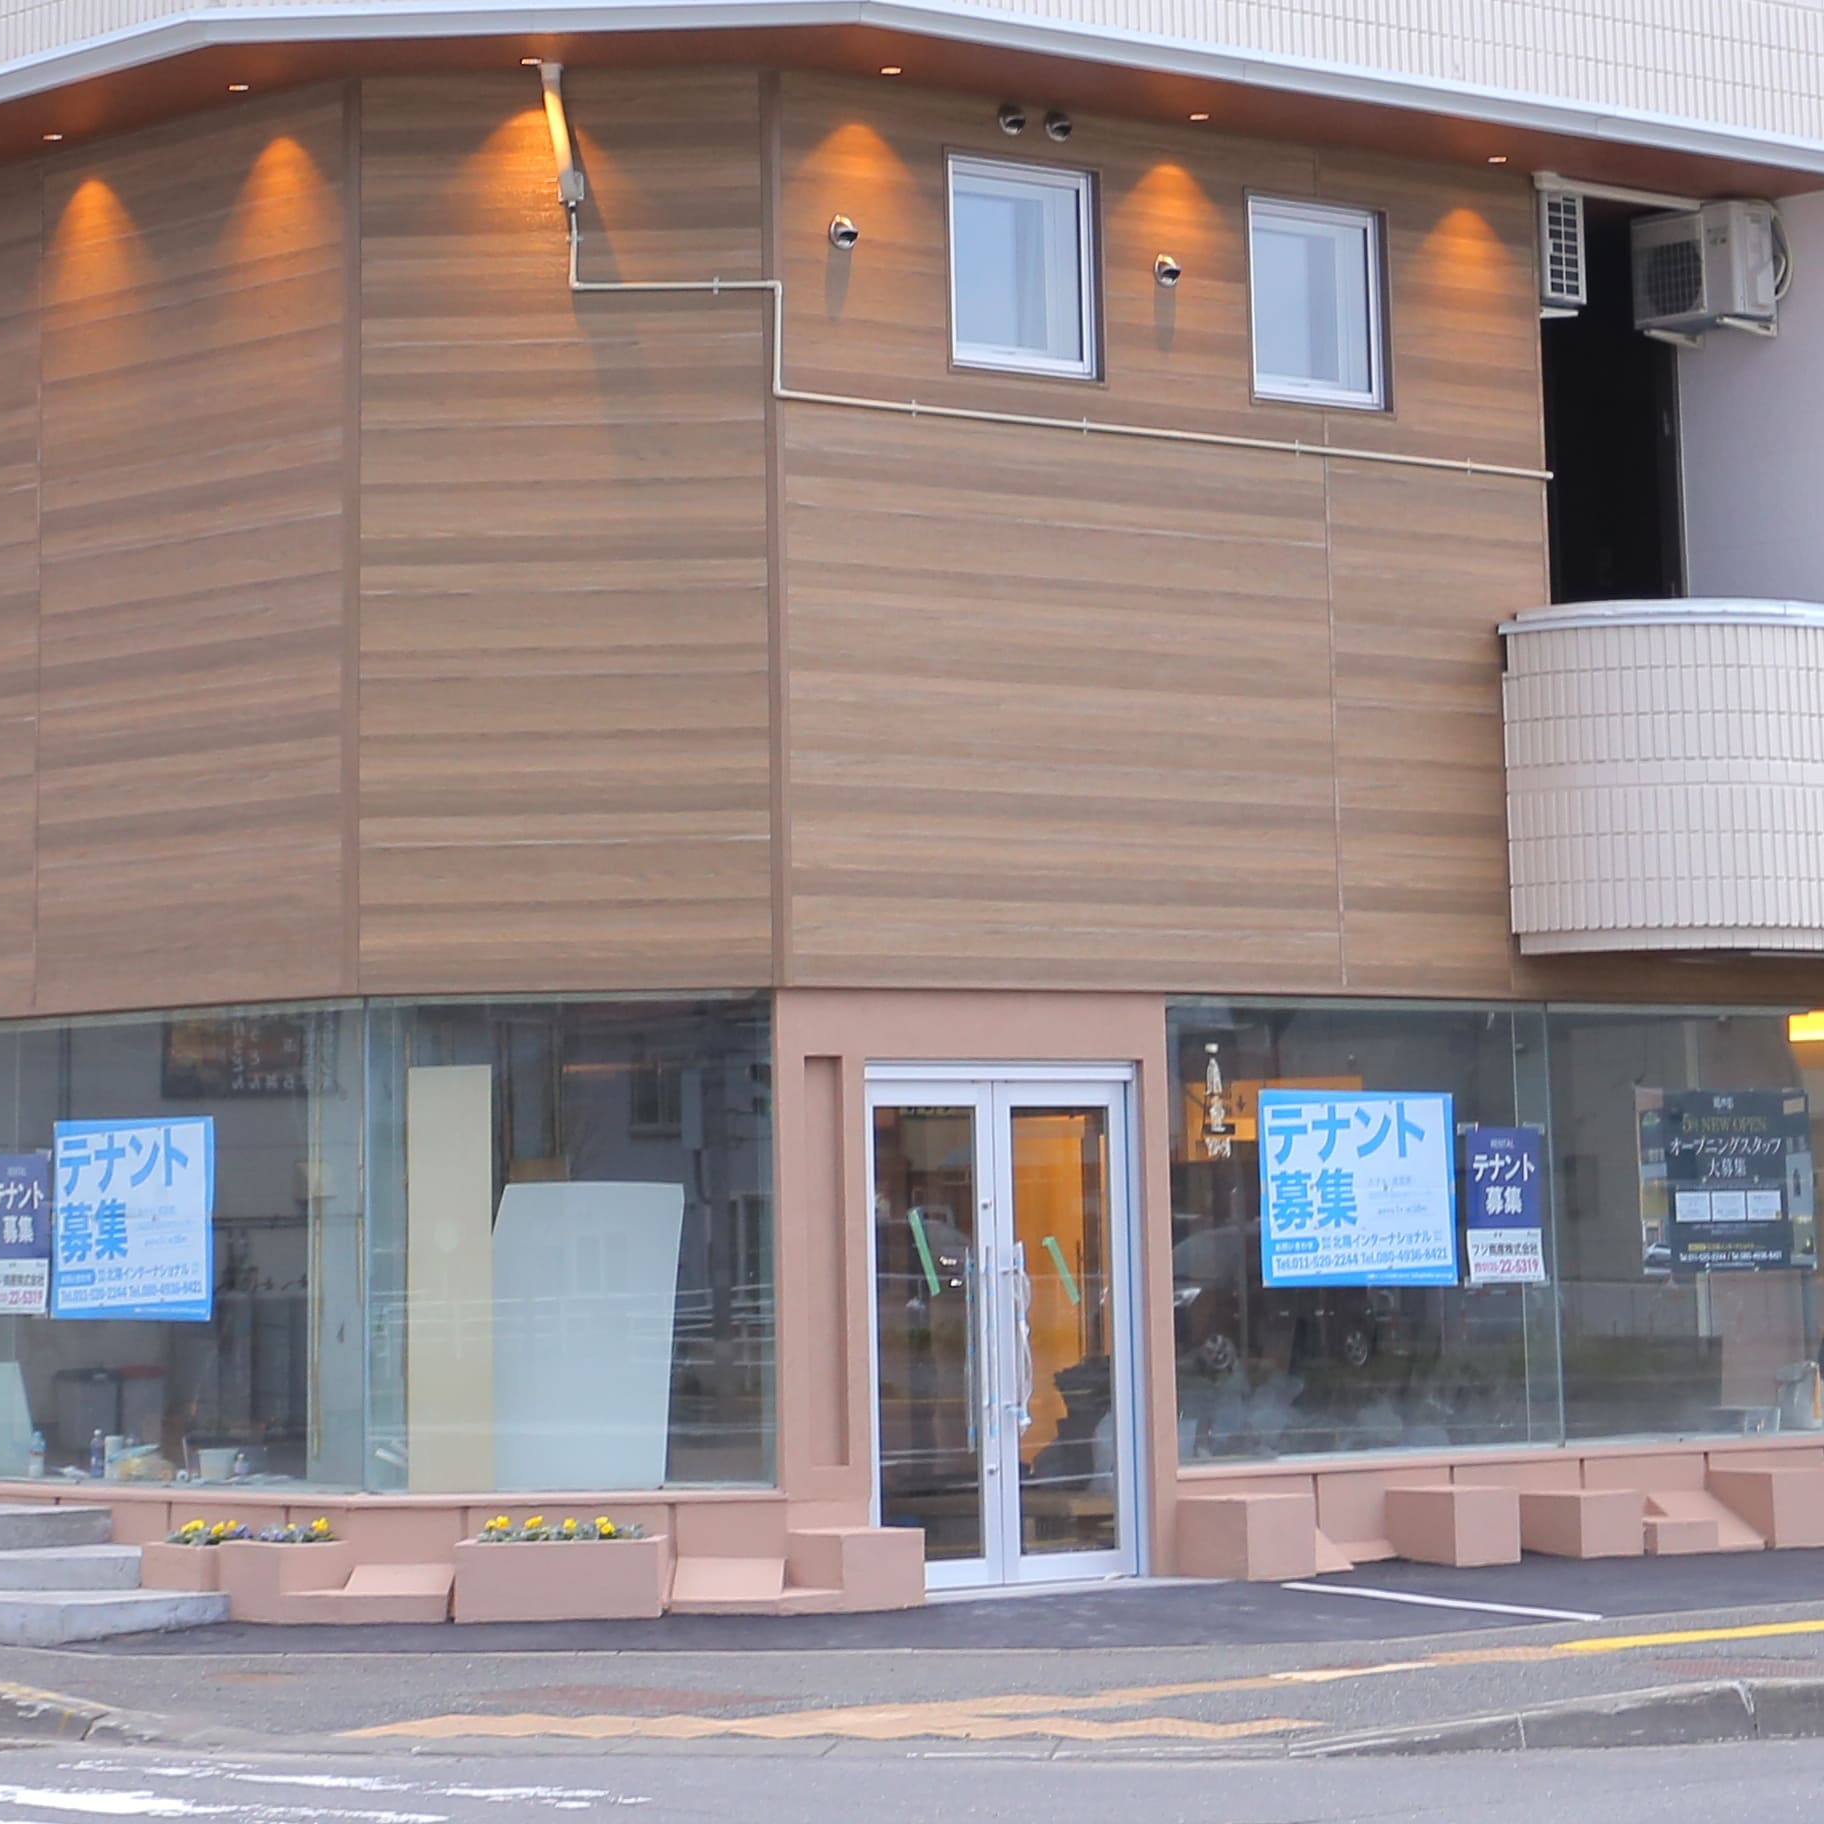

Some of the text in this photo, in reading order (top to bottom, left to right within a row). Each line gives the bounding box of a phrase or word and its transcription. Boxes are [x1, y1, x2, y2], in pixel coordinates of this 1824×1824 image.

[1268, 1102, 1425, 1165] テナント
[1670, 1136, 1781, 1157] オープニングスタッフ
[59, 1127, 189, 1197] テナント
[1472, 1152, 1535, 1182] テナント
[1271, 1168, 1358, 1233] 募集
[1485, 1185, 1523, 1215] 募集
[2, 1215, 34, 1244] 募集
[60, 1198, 128, 1264] 募集
